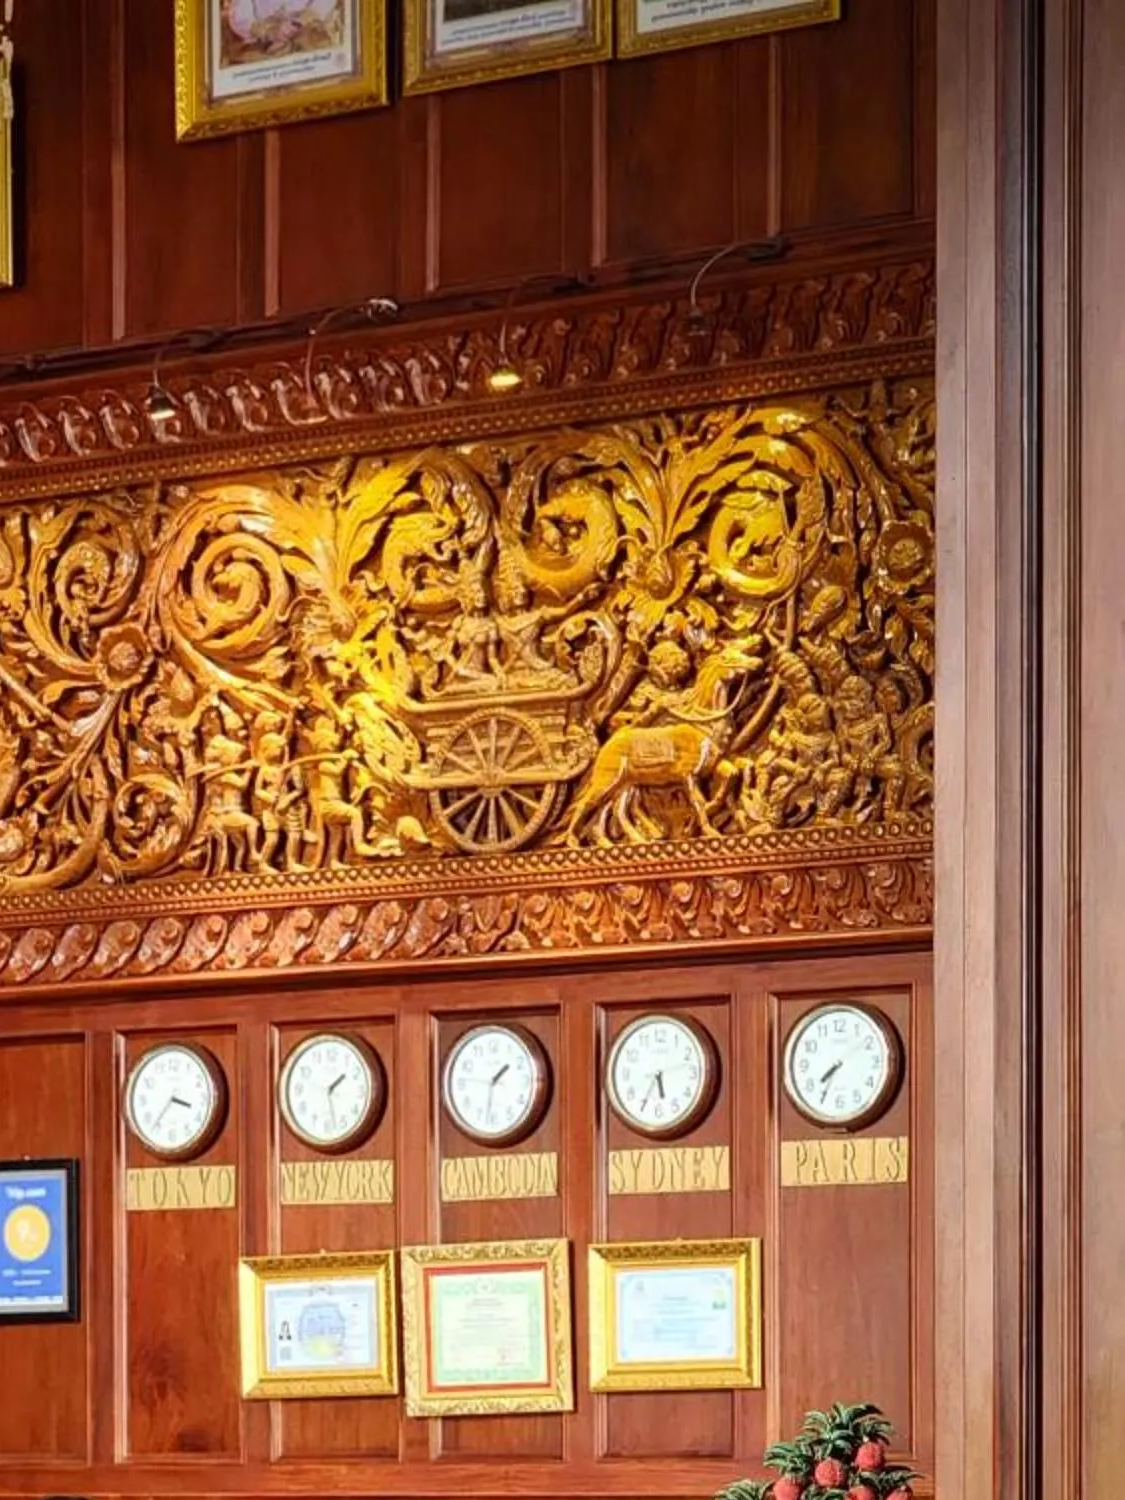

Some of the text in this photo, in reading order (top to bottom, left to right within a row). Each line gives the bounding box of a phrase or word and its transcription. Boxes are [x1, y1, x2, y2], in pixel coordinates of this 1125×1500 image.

[817, 1022, 828, 1038] 11
[832, 1018, 846, 1033] 12
[638, 1033, 649, 1048] 11
[654, 1028, 667, 1044] 12
[864, 1034, 874, 1051] 2
[683, 1045, 692, 1061] 2
[804, 1039, 818, 1054] 10
[626, 1048, 640, 1063] 10
[871, 1054, 881, 1070] 3
[688, 1063, 697, 1080] 3
[799, 1058, 809, 1073] 9
[622, 1066, 630, 1082] 9
[864, 1075, 874, 1089] 4
[626, 1085, 635, 1101] 8
[683, 1085, 692, 1098] 4
[806, 1077, 815, 1093] 8
[835, 1094, 846, 1110] 6
[852, 1089, 862, 1104] 5
[654, 1102, 664, 1119] 6
[670, 1097, 680, 1114] 5
[795, 1137, 902, 1184] PARIS
[612, 1156, 725, 1192] SYDNEY
[129, 1168, 231, 1207] TOKYO
